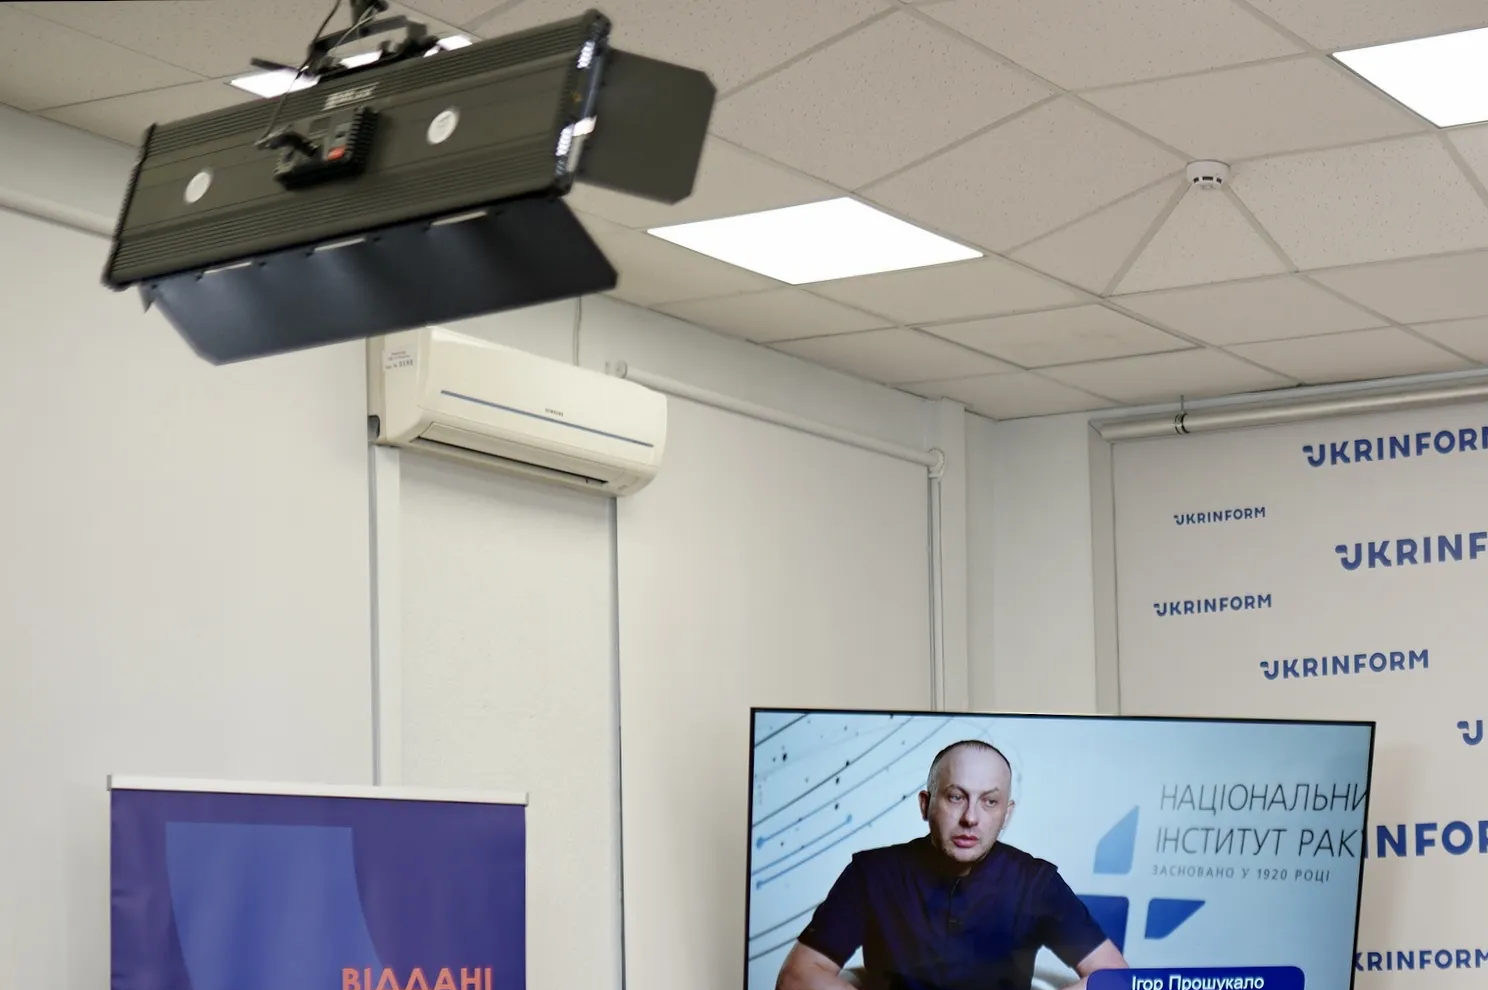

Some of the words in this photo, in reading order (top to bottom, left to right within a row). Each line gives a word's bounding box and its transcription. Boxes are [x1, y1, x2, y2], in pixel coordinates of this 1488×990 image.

[1174, 507, 1265, 525] UKRINFORM
[1153, 594, 1271, 617] UKRINFORM
[1260, 649, 1428, 680] UKRINFORM
[1156, 826, 1288, 856] ІНСТИТУТ
[1298, 828, 1364, 858] РАК
[1152, 864, 1235, 879] ЗАСНОВАНО
[1241, 867, 1250, 880] У
[1257, 868, 1288, 881] 1920
[1294, 869, 1330, 883] РОЦІ
